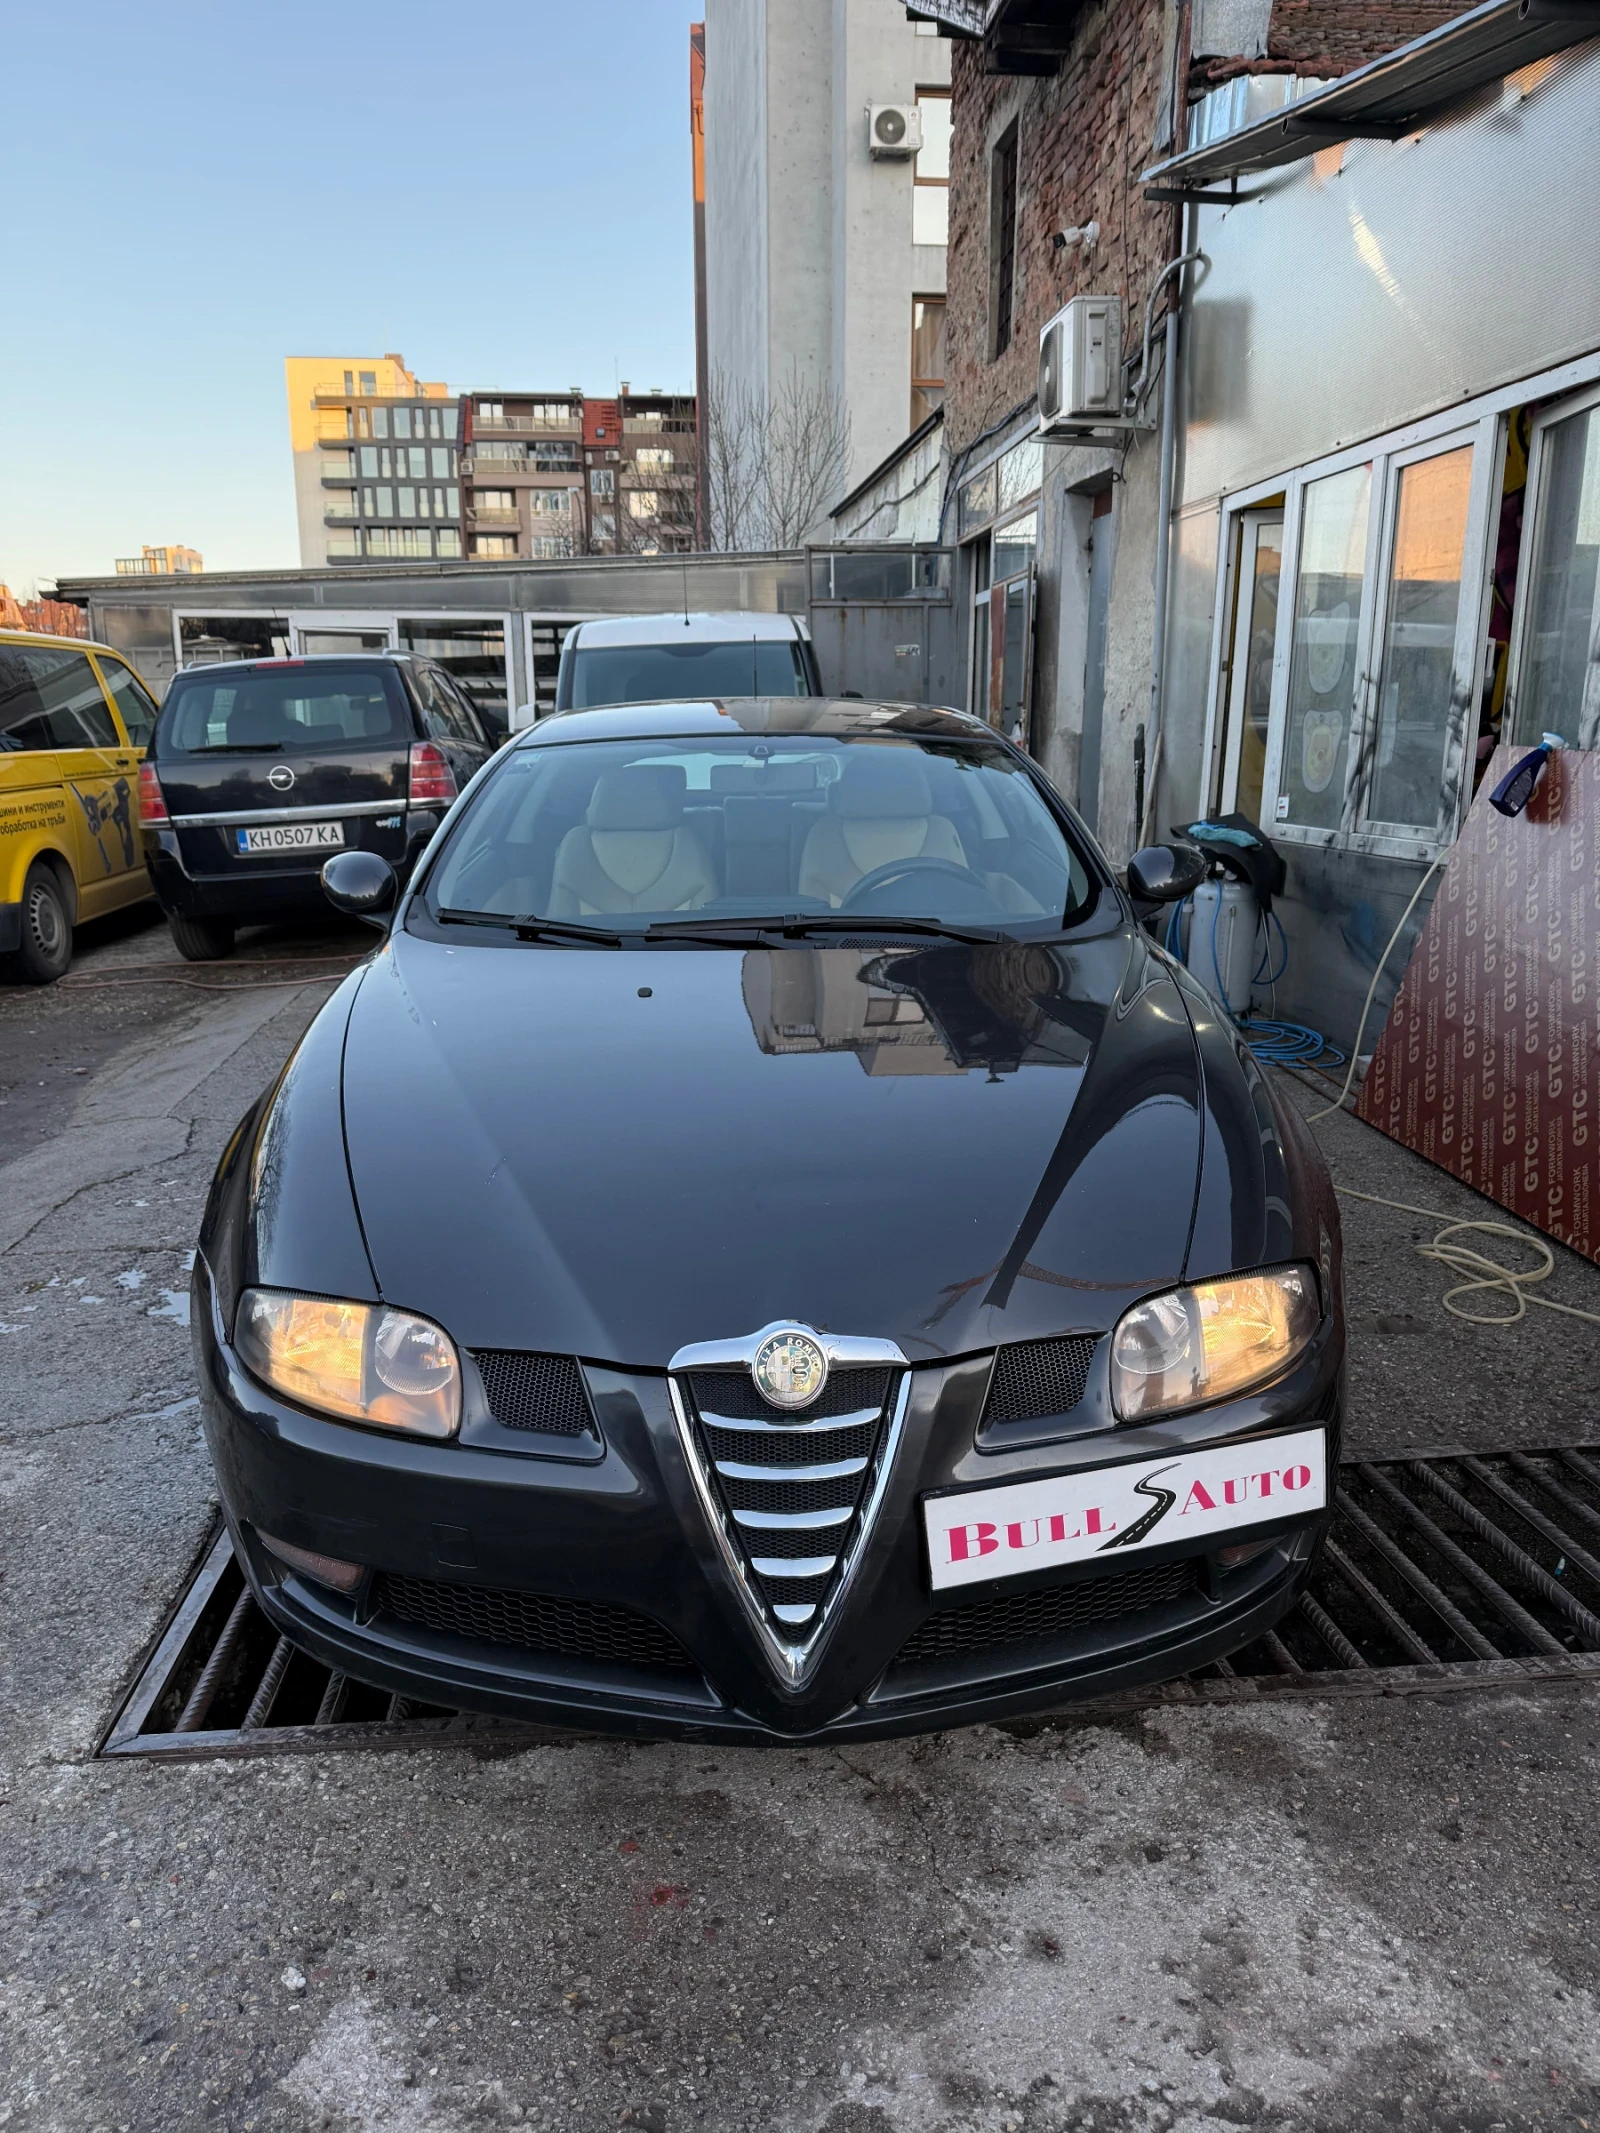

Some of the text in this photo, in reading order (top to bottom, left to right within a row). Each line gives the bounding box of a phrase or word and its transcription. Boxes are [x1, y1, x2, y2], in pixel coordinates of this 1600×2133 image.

[0, 812, 66, 836] обработка на тръби
[24, 799, 65, 814] инструменти
[1486, 807, 1499, 854] GTC
[1547, 786, 1561, 836] GTC
[248, 826, 340, 848] KH 0507 KA
[1570, 820, 1584, 872] GTC
[1448, 856, 1460, 902] GTC
[1505, 840, 1518, 888] GTC
[1465, 890, 1478, 937] GTC
[1525, 873, 1539, 924] GTC
[1428, 936, 1440, 983] GTC
[1484, 923, 1497, 974] GTC
[1547, 910, 1562, 962] GTC
[1570, 890, 1586, 1004] GTC FORMWORK
[1444, 971, 1457, 1020] GTC
[1503, 961, 1517, 1012] GTC
[1524, 940, 1539, 1054] GTC FORMWORK
[1409, 1016, 1420, 1064] GTC
[1425, 998, 1437, 1103] GTC FORMWORK
[1463, 1010, 1476, 1059] GTC
[1547, 980, 1563, 1098] GTC FORMWORK
[1374, 1058, 1385, 1105] GTC
[1482, 1049, 1496, 1101] GTC
[1502, 1030, 1517, 1145] GTC FORMWORK
[1572, 1023, 1588, 1146] GTC FORMWORK
[1442, 1094, 1455, 1144] GTC
[1461, 1076, 1469, 1137] FORMWORK
[1524, 1072, 1539, 1191] GTC FORMWORK
[1481, 1119, 1489, 1181] FORMWORK
[1548, 1118, 1563, 1238] GTC FORMWORK
[1573, 1166, 1581, 1238] FORMWORK
[945, 1506, 1116, 1564] BULL
[1177, 1464, 1312, 1516] AUTO
